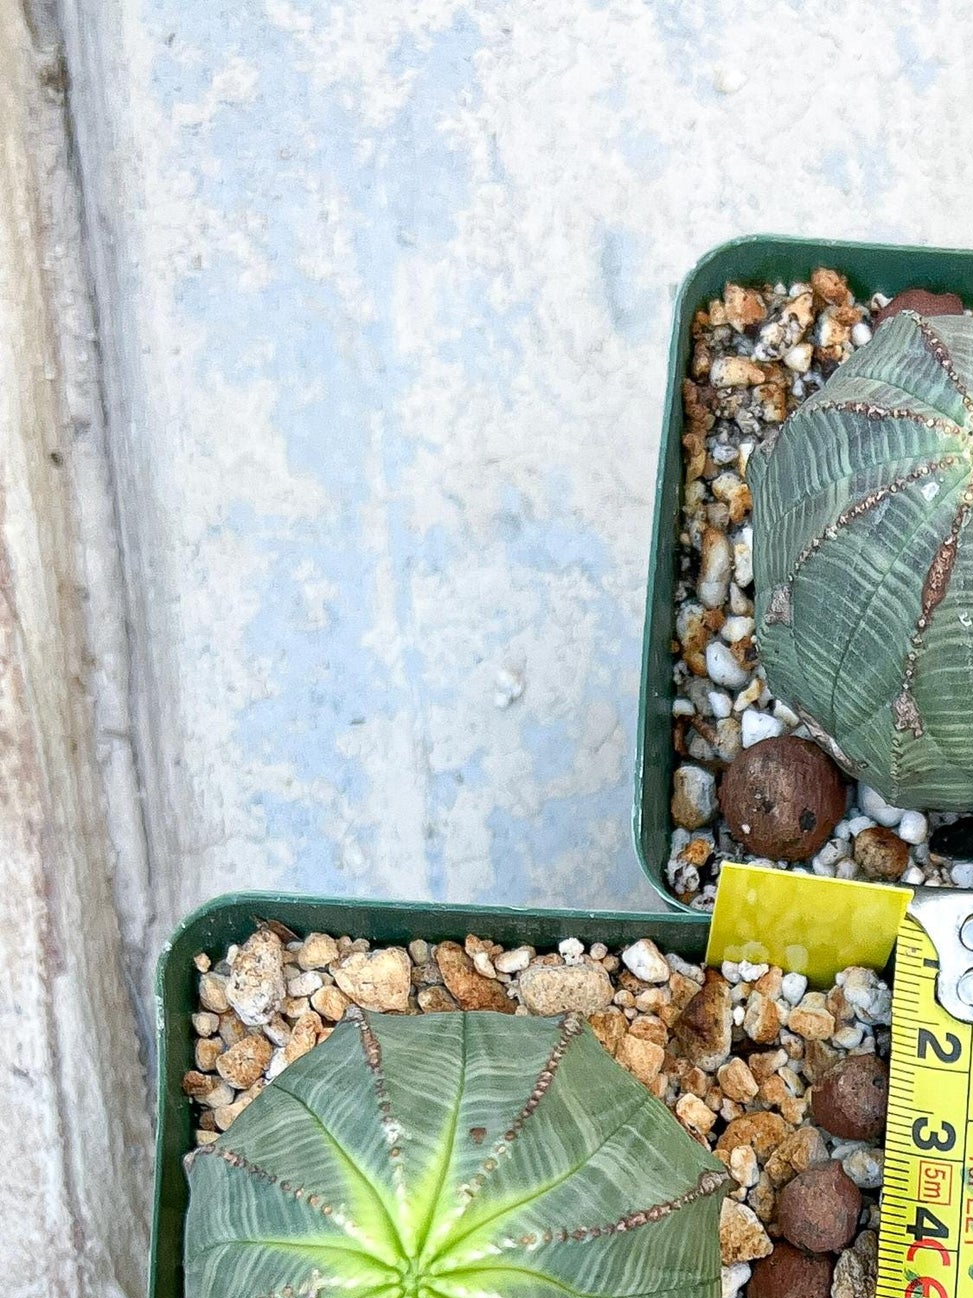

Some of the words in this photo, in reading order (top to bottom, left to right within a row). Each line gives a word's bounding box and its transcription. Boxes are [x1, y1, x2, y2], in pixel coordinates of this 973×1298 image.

[917, 1028, 962, 1064] 2
[912, 1117, 956, 1150] 3
[922, 1168, 946, 1199] 5m
[906, 1206, 949, 1241] 4
